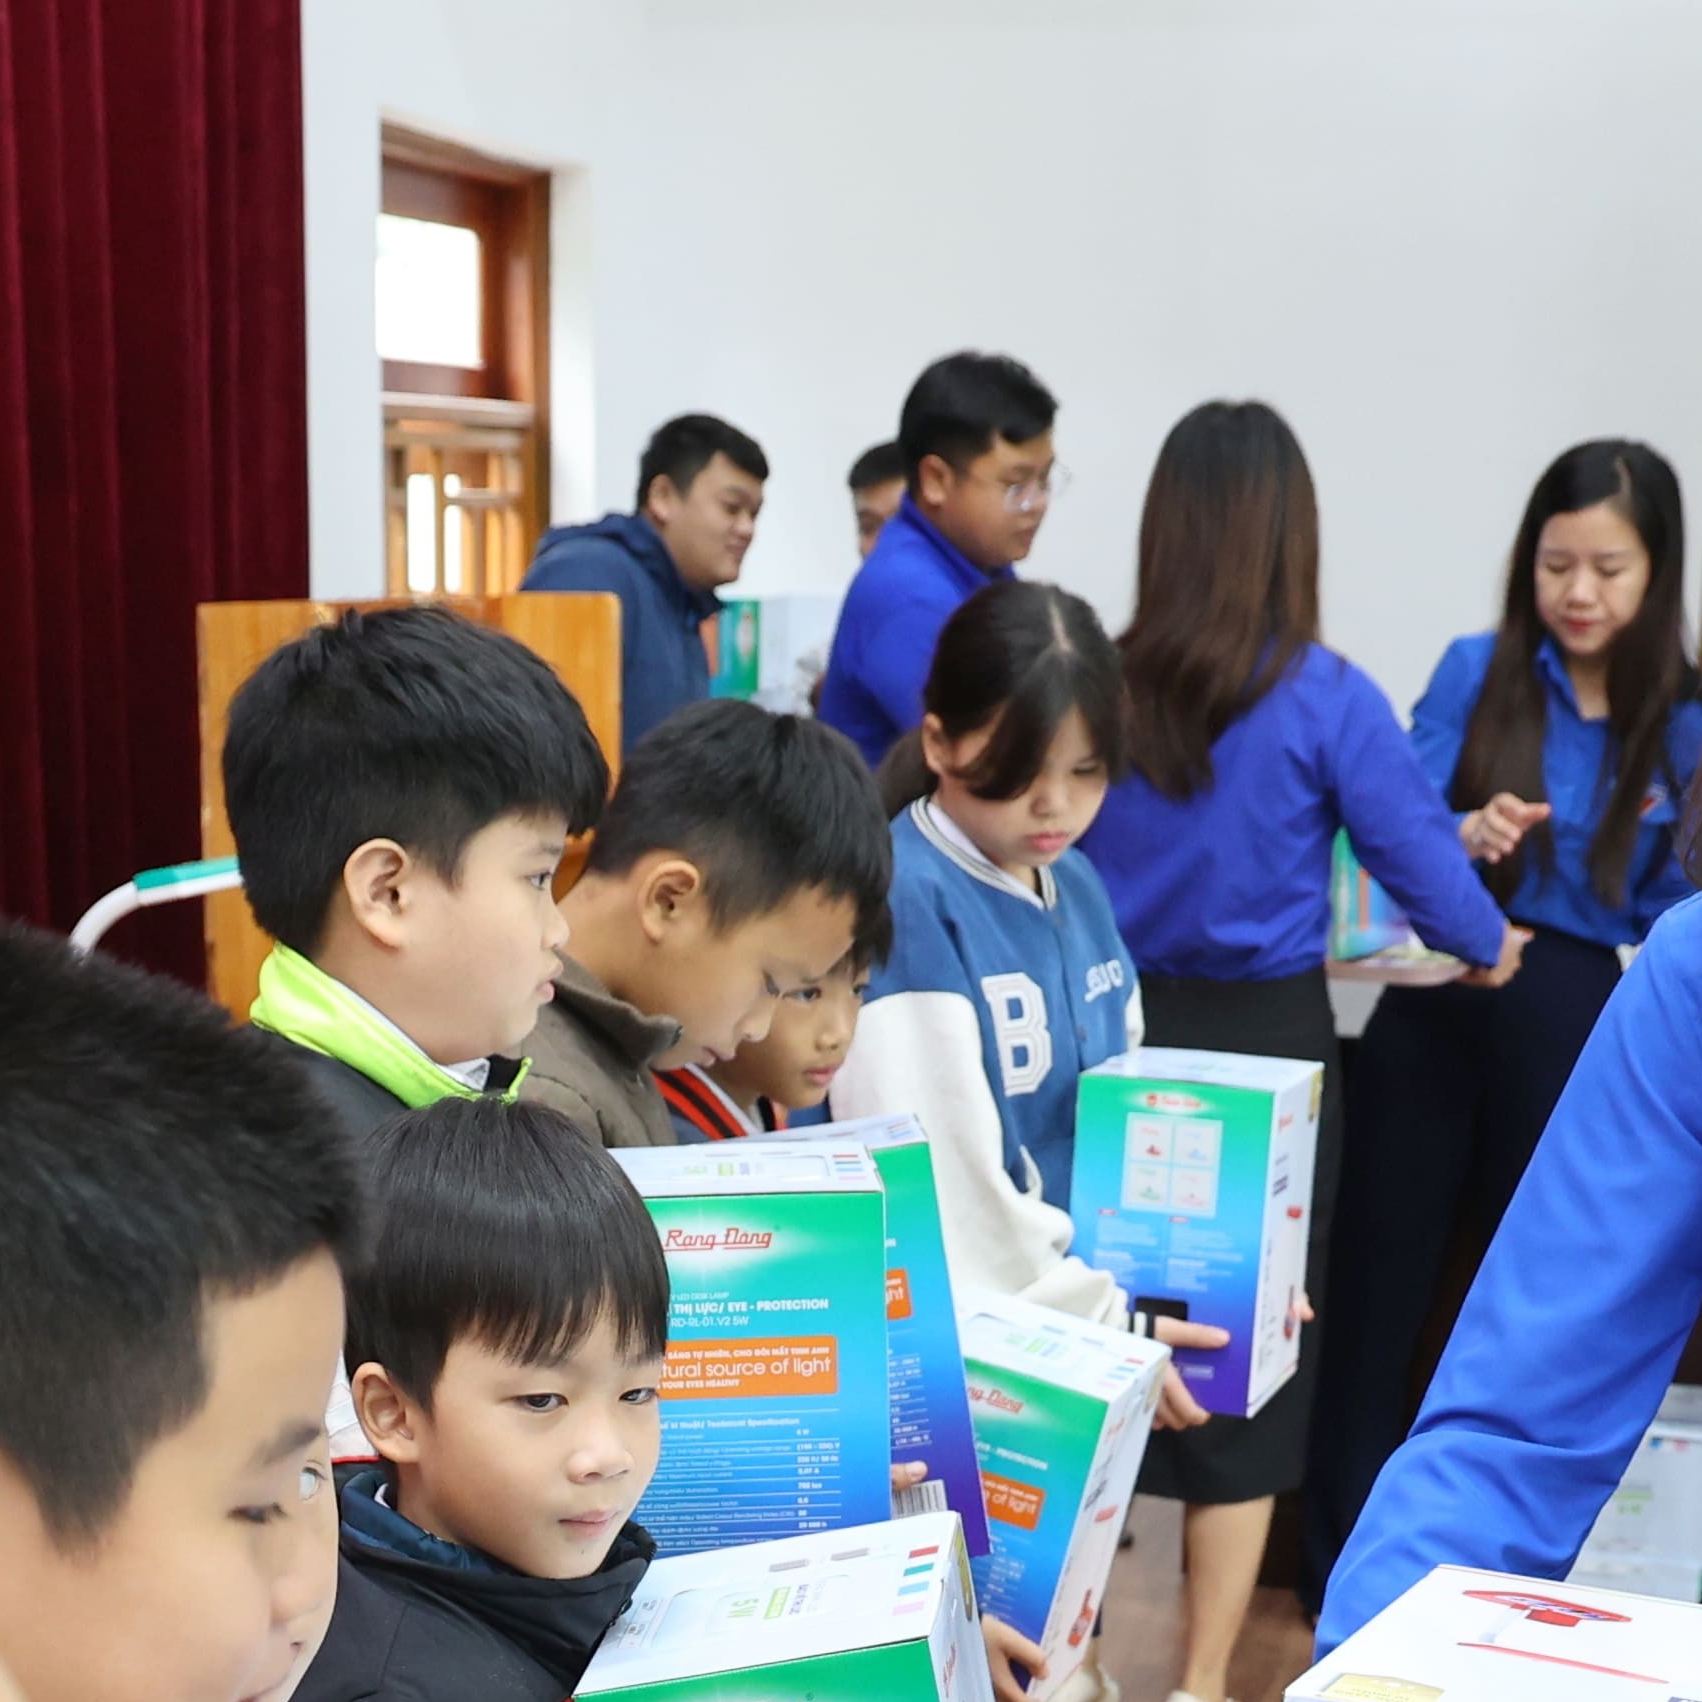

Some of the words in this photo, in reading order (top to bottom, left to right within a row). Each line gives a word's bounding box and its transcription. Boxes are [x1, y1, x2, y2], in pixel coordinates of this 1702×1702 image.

[981, 971, 1053, 1097] B
[728, 1301, 747, 1312] EYE
[757, 1298, 829, 1312] PROTECTION
[662, 1361, 701, 1378] tural
[705, 1361, 766, 1377] source
[770, 1358, 790, 1374] of
[793, 1357, 832, 1377] light
